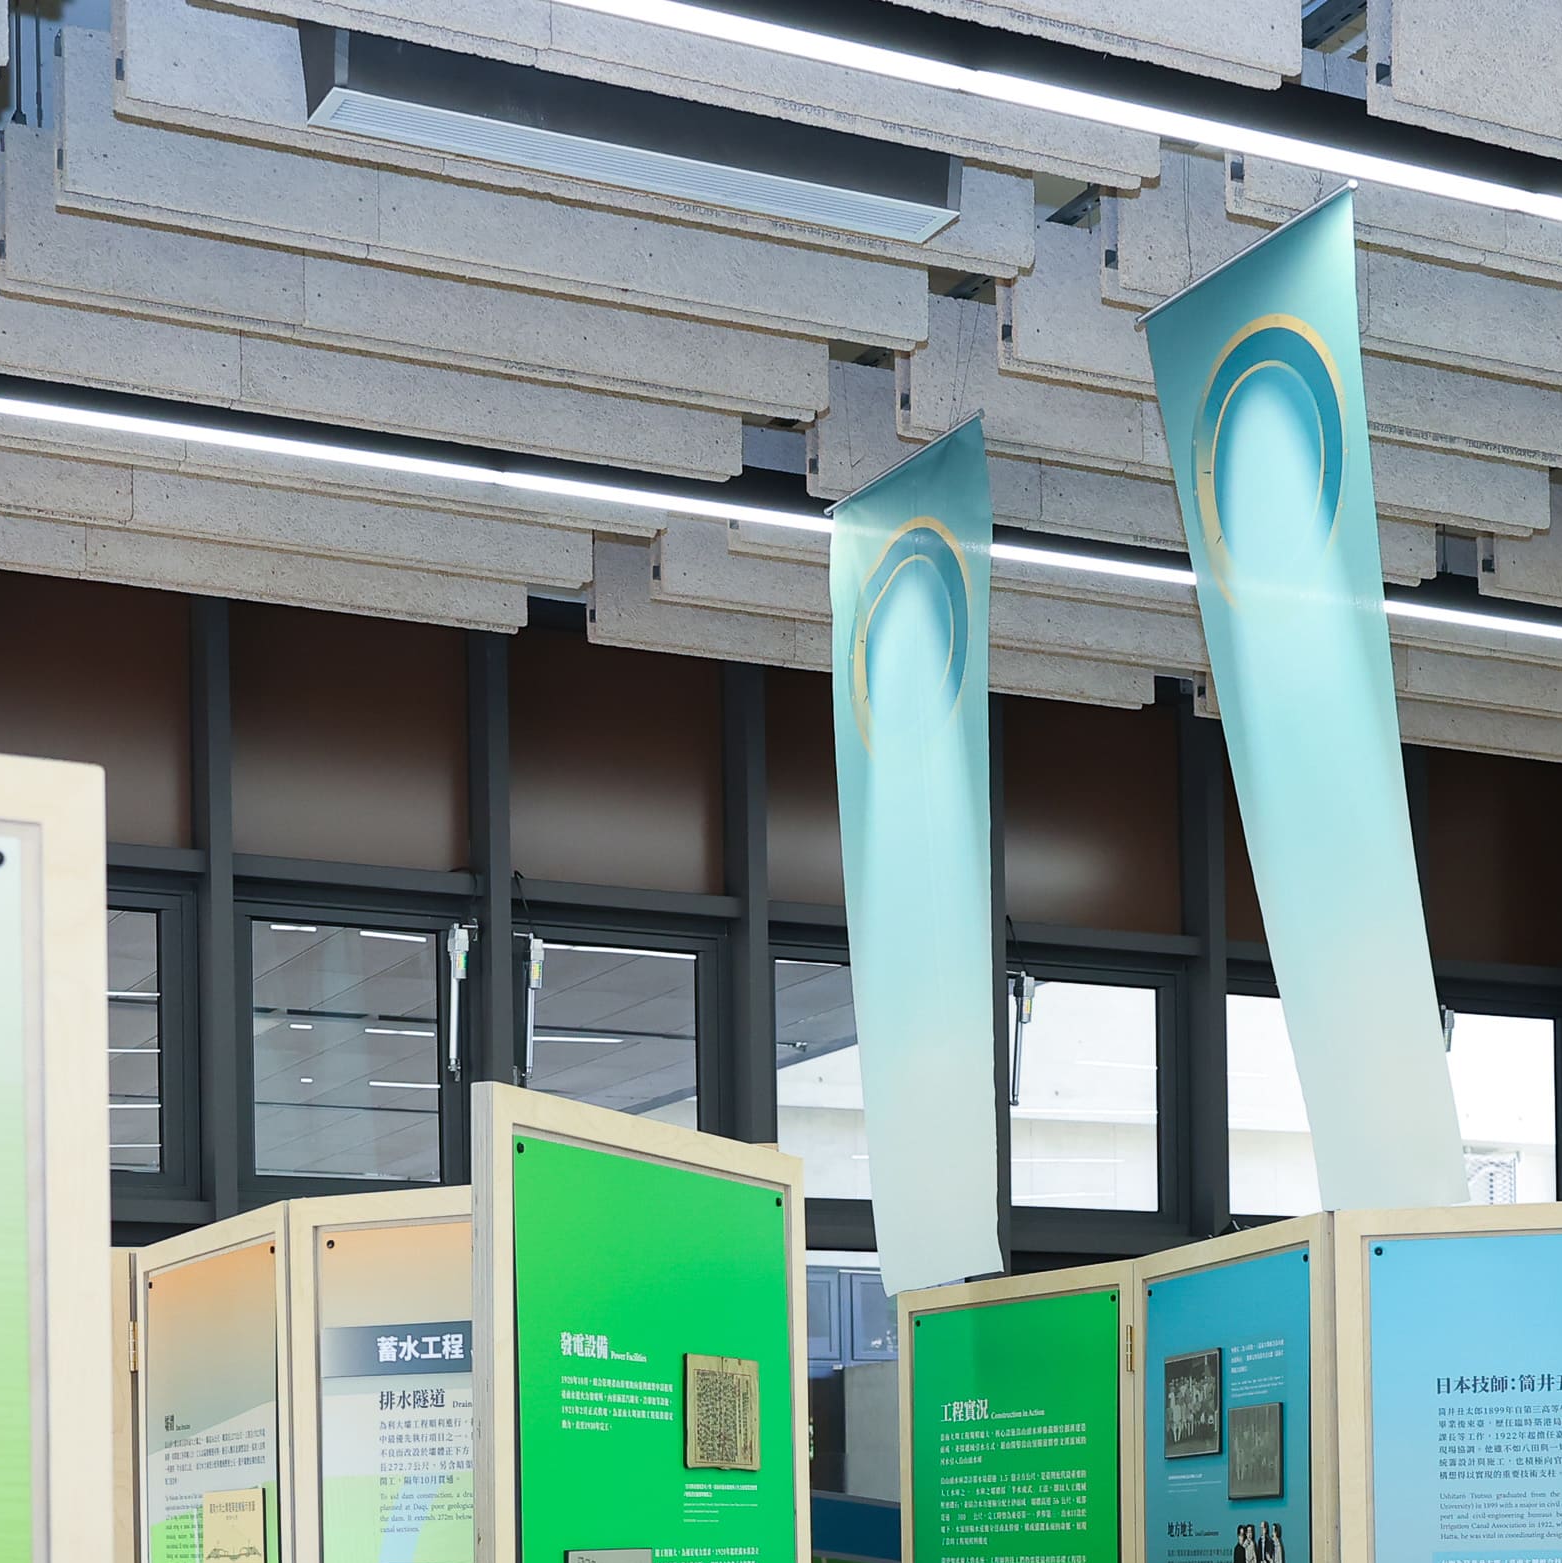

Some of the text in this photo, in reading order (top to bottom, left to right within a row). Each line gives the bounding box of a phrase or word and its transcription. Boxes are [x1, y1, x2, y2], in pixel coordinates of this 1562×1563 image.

[376, 1334, 464, 1363] 蓄水工程
[560, 1331, 609, 1360] 發電設備
[379, 1388, 446, 1411] 排水隧道
[940, 1398, 989, 1423] 工程實況
